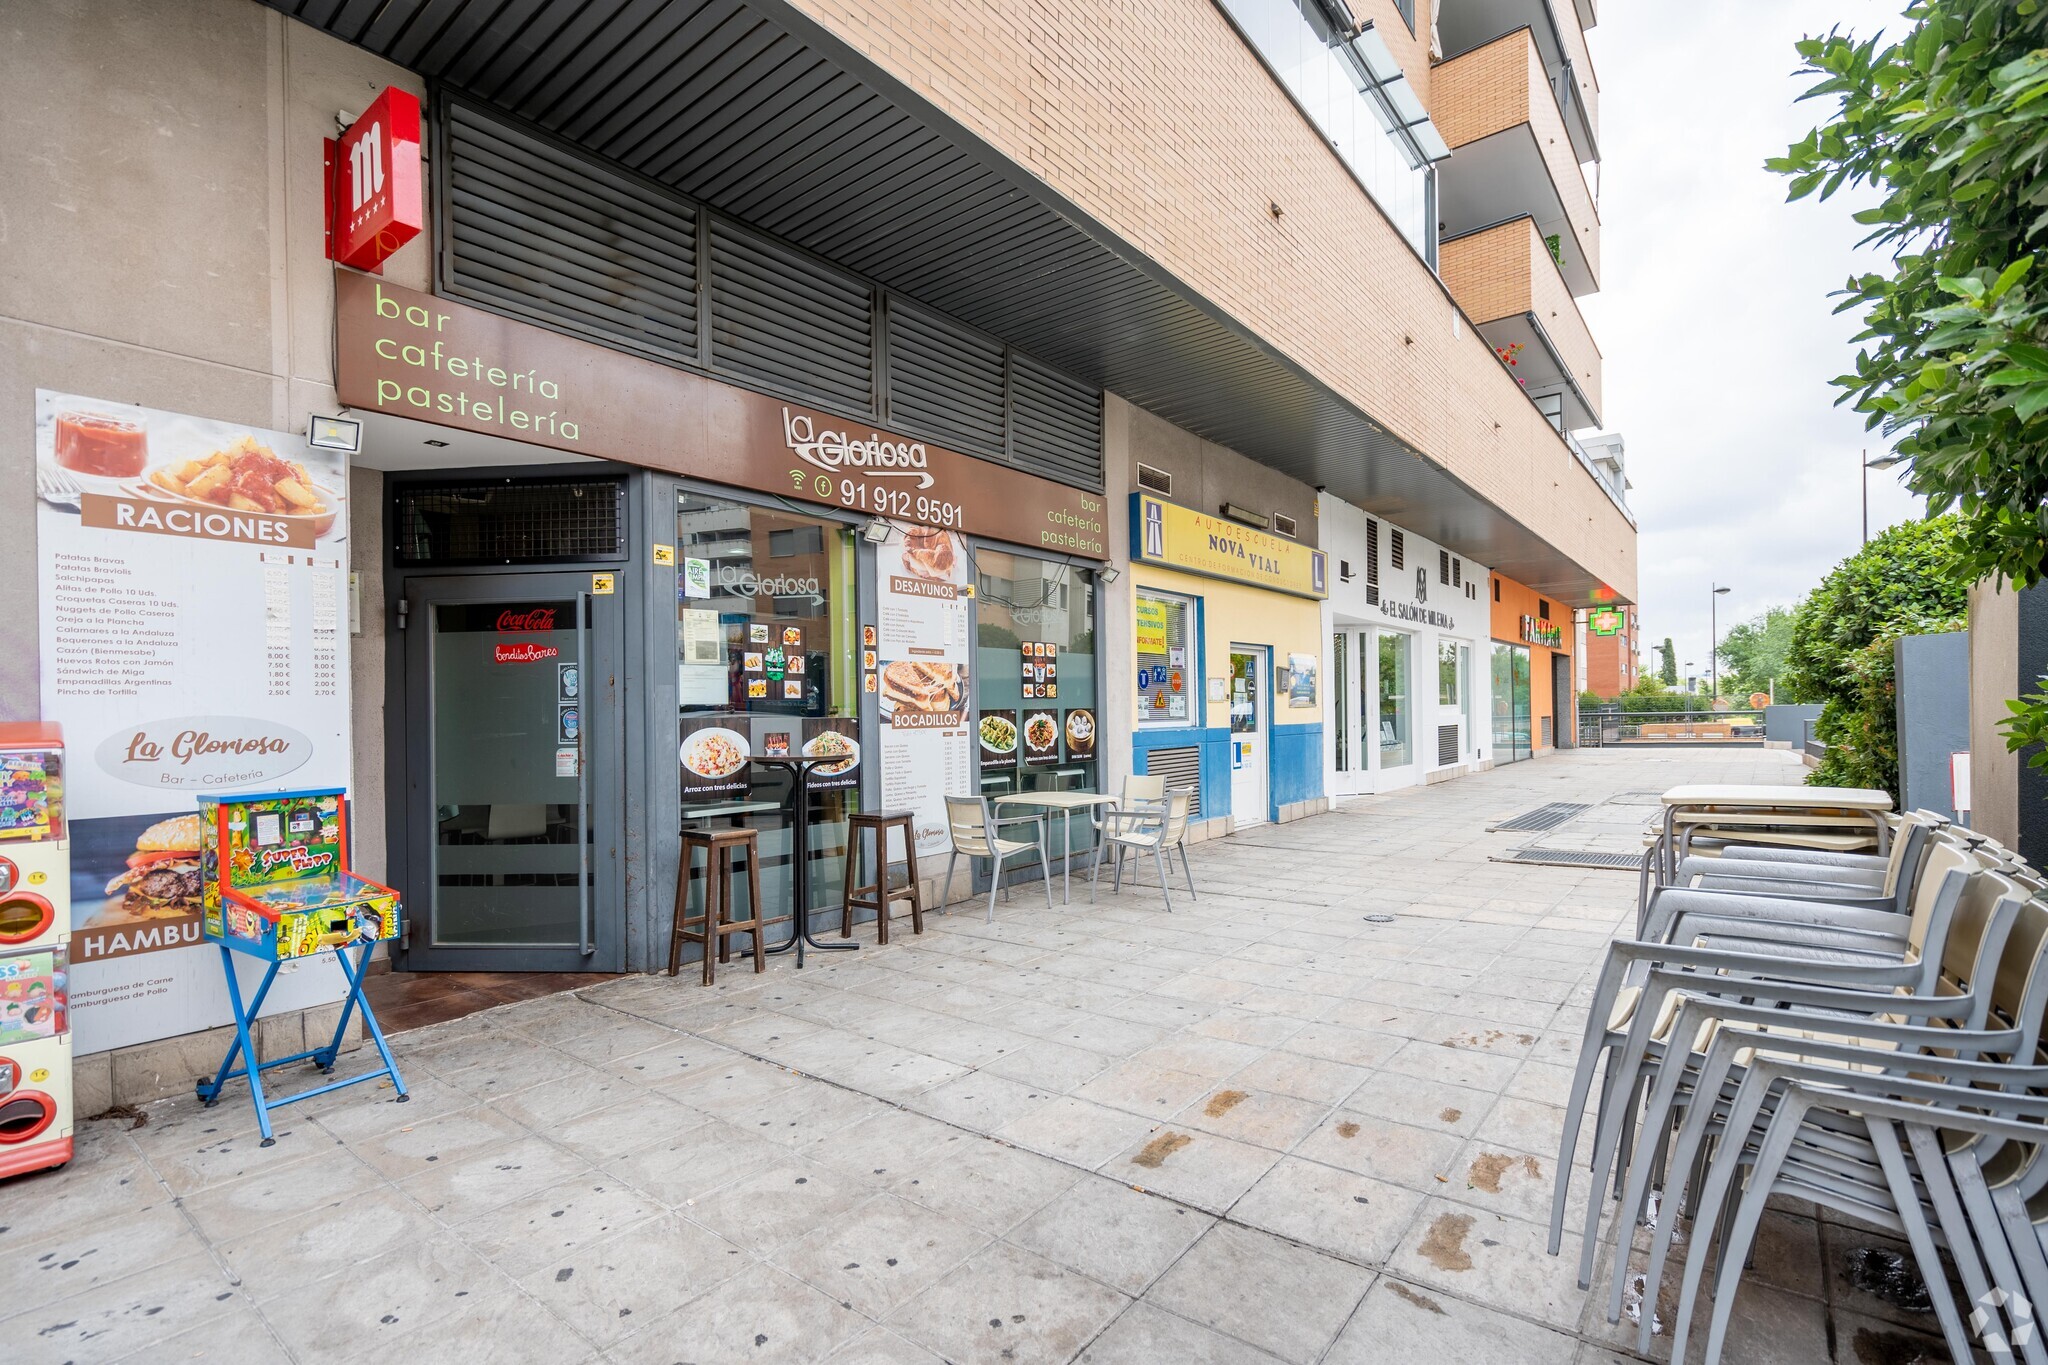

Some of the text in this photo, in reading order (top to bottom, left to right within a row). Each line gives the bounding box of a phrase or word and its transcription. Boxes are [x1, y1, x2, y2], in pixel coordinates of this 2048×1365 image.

[376, 284, 450, 331] bar
[375, 338, 558, 399] cafetería
[378, 379, 579, 440] pastelería
[818, 430, 927, 469] Gloriosa
[840, 479, 962, 528] 91 912 9591
[1081, 493, 1101, 513] bar
[117, 503, 289, 543] RACIONES
[1047, 508, 1101, 533] cafetería
[1041, 530, 1102, 554] pastelería
[1195, 516, 1290, 554] AUTOESCUELA
[55, 553, 91, 562] Patatas
[1180, 554, 1206, 566] CENTRO
[1208, 559, 1216, 568] DE
[1209, 534, 1280, 574] NOVA VIAL
[55, 564, 132, 575] Patatas Braviolis
[55, 574, 114, 584] Salchipapas
[740, 573, 819, 596] Gloriosa
[895, 580, 954, 598] DESAYUNOS
[56, 595, 105, 604] Croquetas
[56, 606, 96, 614] Nuggets
[56, 616, 83, 624] Oreja
[497, 609, 558, 631] Coca-Cola
[1136, 606, 1158, 615] CURSOS
[1390, 601, 1397, 618] EL
[1398, 602, 1418, 622] SALÓN
[1419, 608, 1427, 624] DE
[56, 626, 109, 634] Calamares
[91, 648, 155, 656] (Bienmesabe)
[894, 714, 958, 726] BOCADILLOS
[123, 731, 290, 764] La Gloriosa
[161, 773, 185, 784] Bar
[203, 770, 263, 784] Cafetería
[262, 846, 307, 866] SUPER
[147, 976, 173, 986] Carne
[147, 987, 168, 996] Pollo
